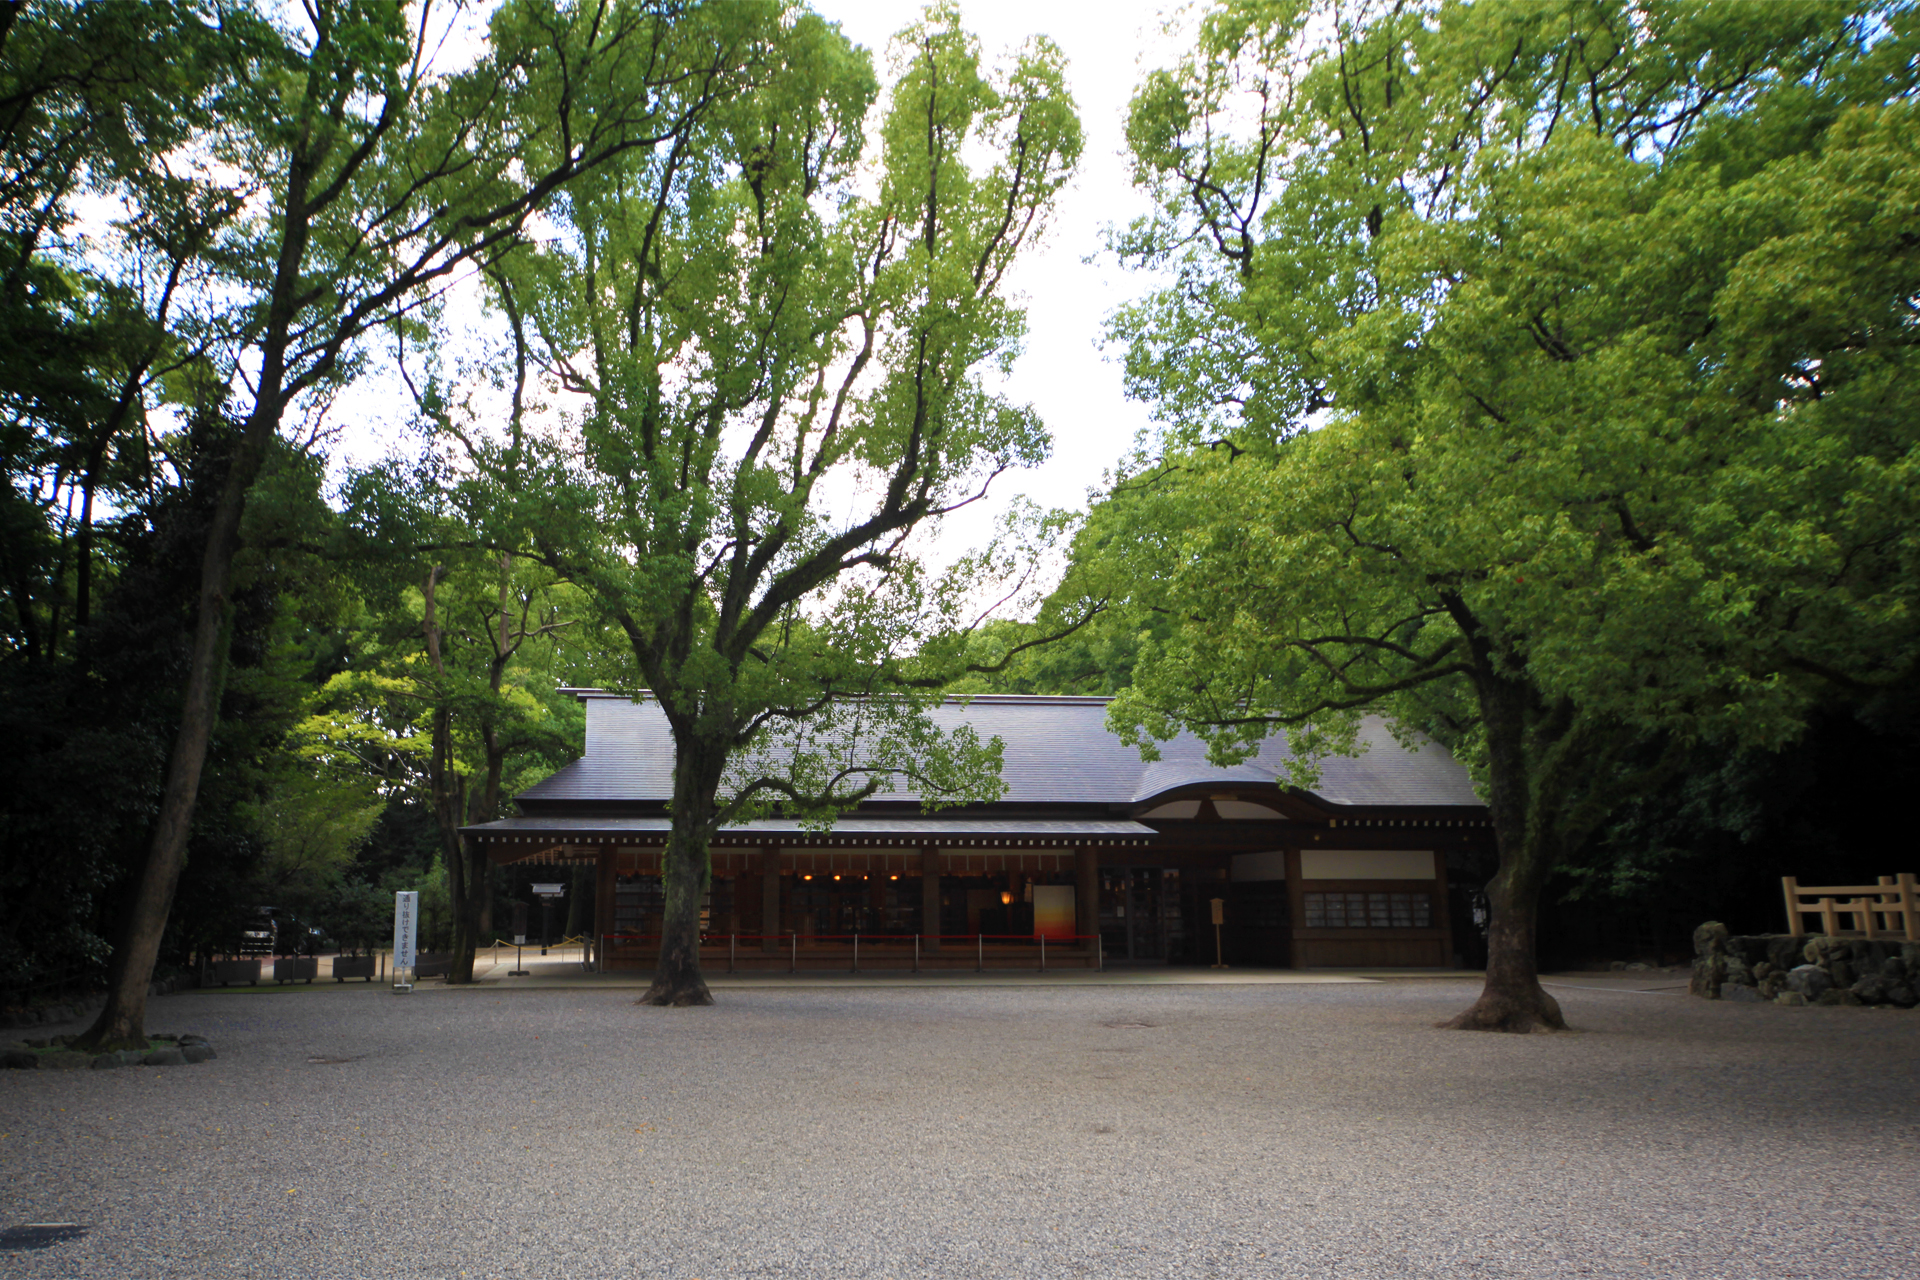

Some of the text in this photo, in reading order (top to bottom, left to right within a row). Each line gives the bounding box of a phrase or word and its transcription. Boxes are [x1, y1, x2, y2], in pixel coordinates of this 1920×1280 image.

[400, 894, 411, 966] 通り抜けできません
